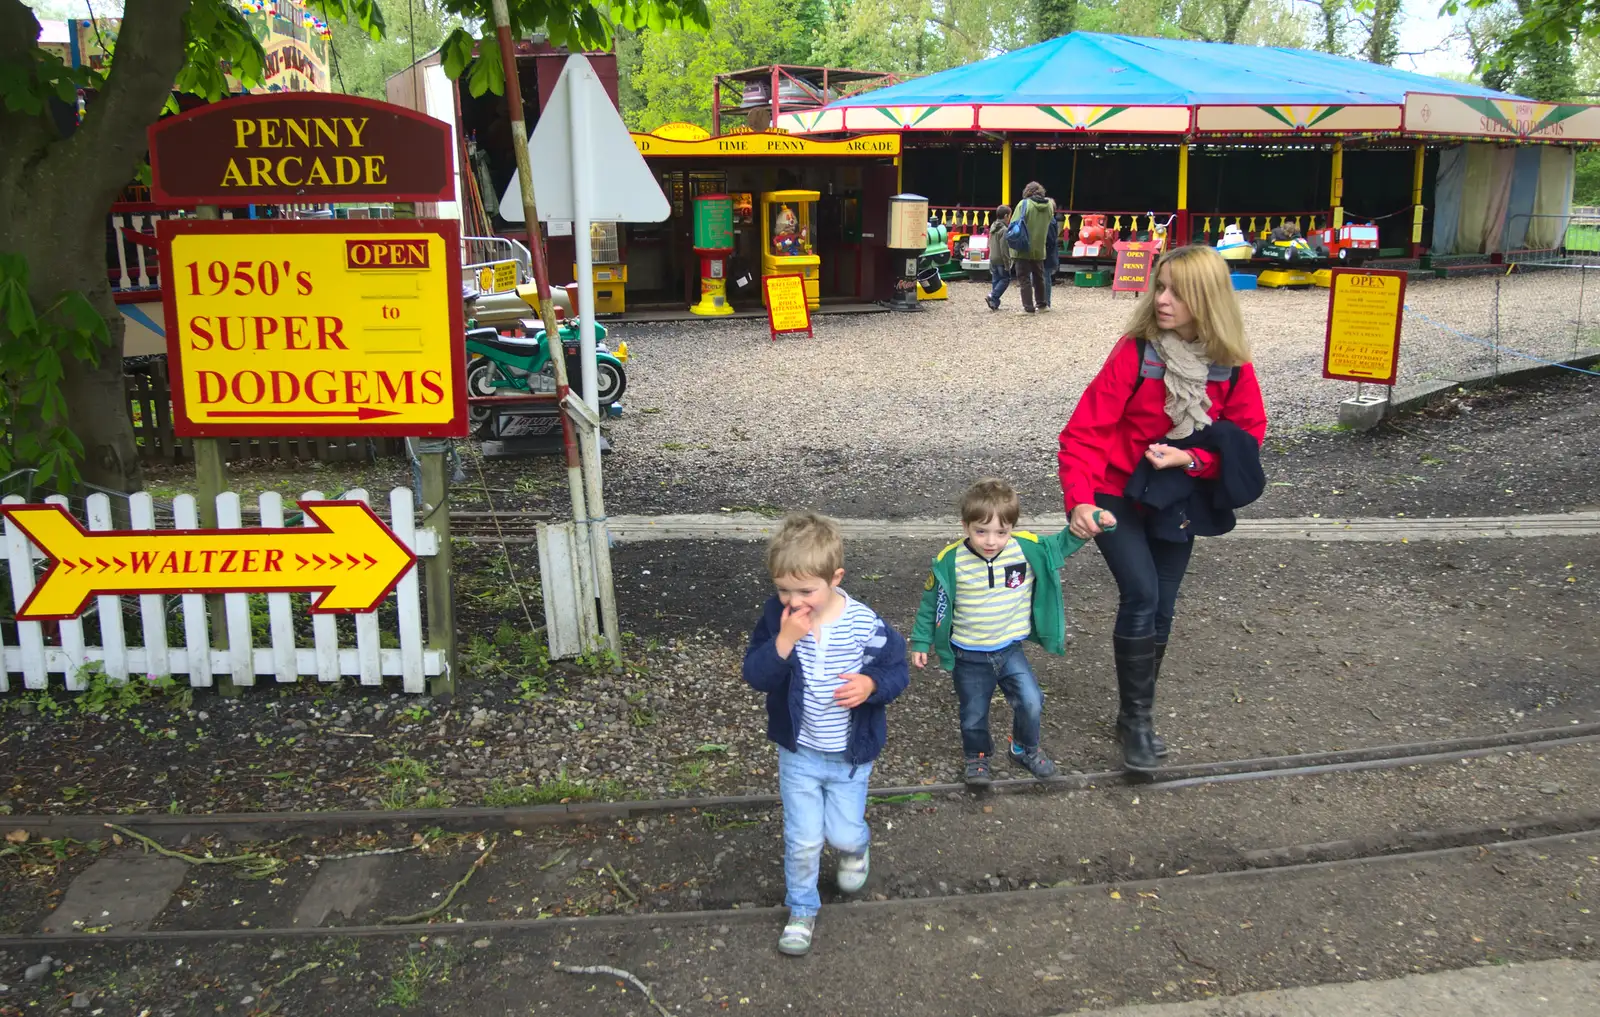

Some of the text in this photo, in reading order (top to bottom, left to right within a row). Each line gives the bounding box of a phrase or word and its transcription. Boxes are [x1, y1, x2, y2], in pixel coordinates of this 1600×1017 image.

[232, 117, 370, 149] PENNY
[1480, 116, 1564, 136] SUPER DODGEMS
[718, 140, 748, 151] TIME
[767, 140, 806, 151] PENNY
[846, 141, 893, 151] ARCADE
[219, 155, 388, 187] ARCADE
[350, 243, 426, 266] OPEN
[185, 260, 313, 296] 1950's
[1351, 275, 1386, 286] OPEN
[381, 304, 401, 320] to
[189, 315, 349, 351] SUPER
[196, 370, 445, 405] DODGEMS
[129, 549, 285, 574] WALTZER
